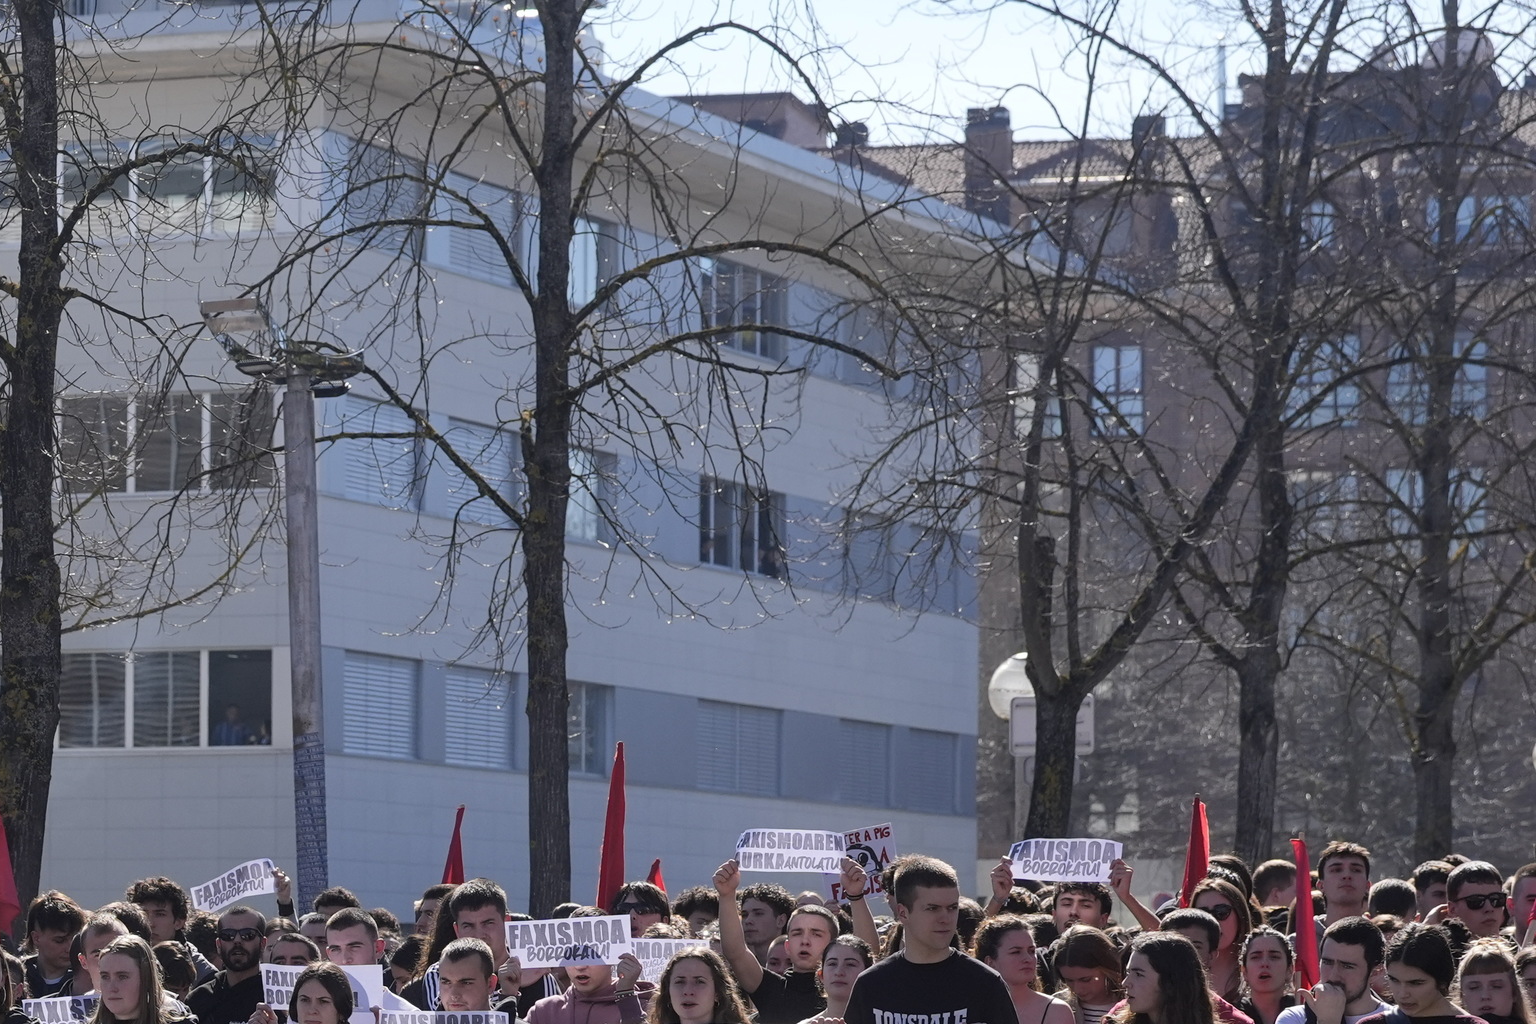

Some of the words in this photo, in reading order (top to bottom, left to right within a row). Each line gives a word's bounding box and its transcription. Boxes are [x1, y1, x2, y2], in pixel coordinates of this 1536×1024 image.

[873, 826, 891, 840] PIG
[1009, 840, 1116, 864] FAXISMOA
[1022, 860, 1102, 878] BORROKATU!
[194, 860, 274, 907] FAXISMOA
[208, 878, 264, 910] BORROKATU!
[508, 919, 626, 950] FAXISMOA
[526, 941, 611, 962] BORROKATU!
